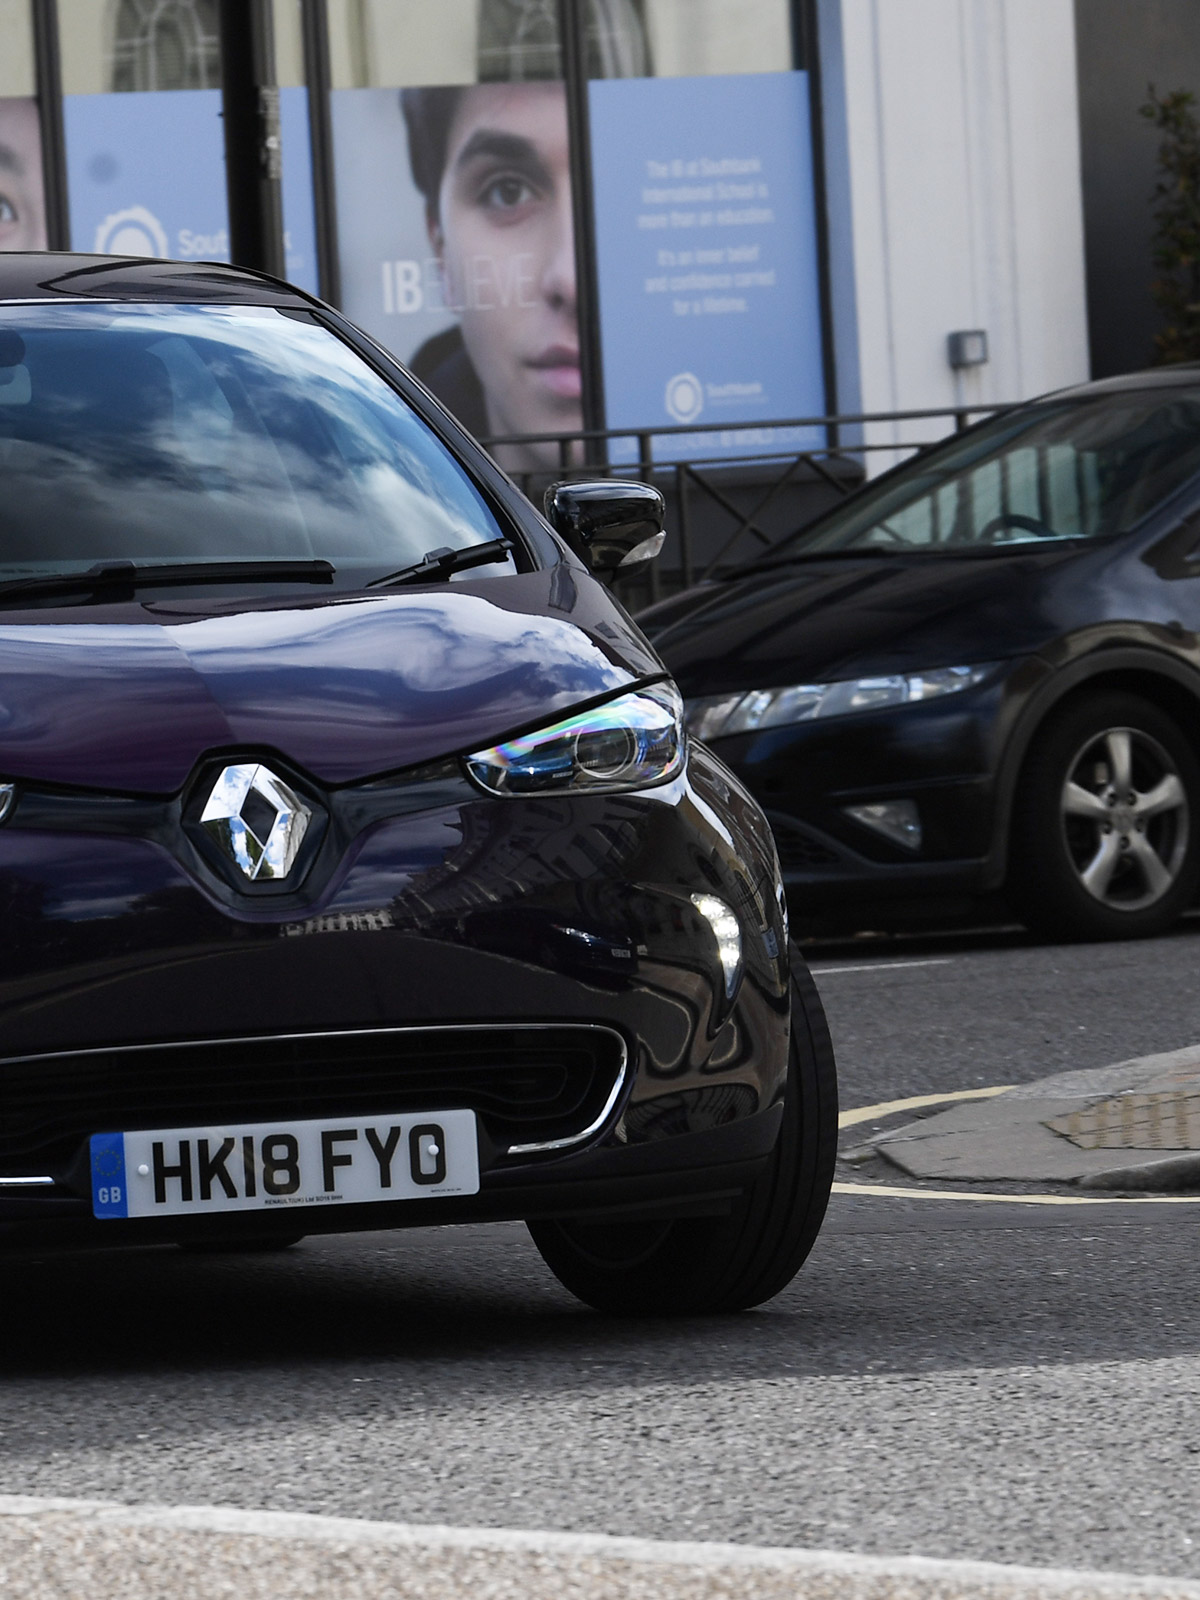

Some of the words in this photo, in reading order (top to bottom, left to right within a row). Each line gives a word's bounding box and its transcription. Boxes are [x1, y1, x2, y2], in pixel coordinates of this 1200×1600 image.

[152, 1133, 301, 1204] HK18
[320, 1123, 447, 1193] FYO
[98, 1186, 122, 1204] GB
